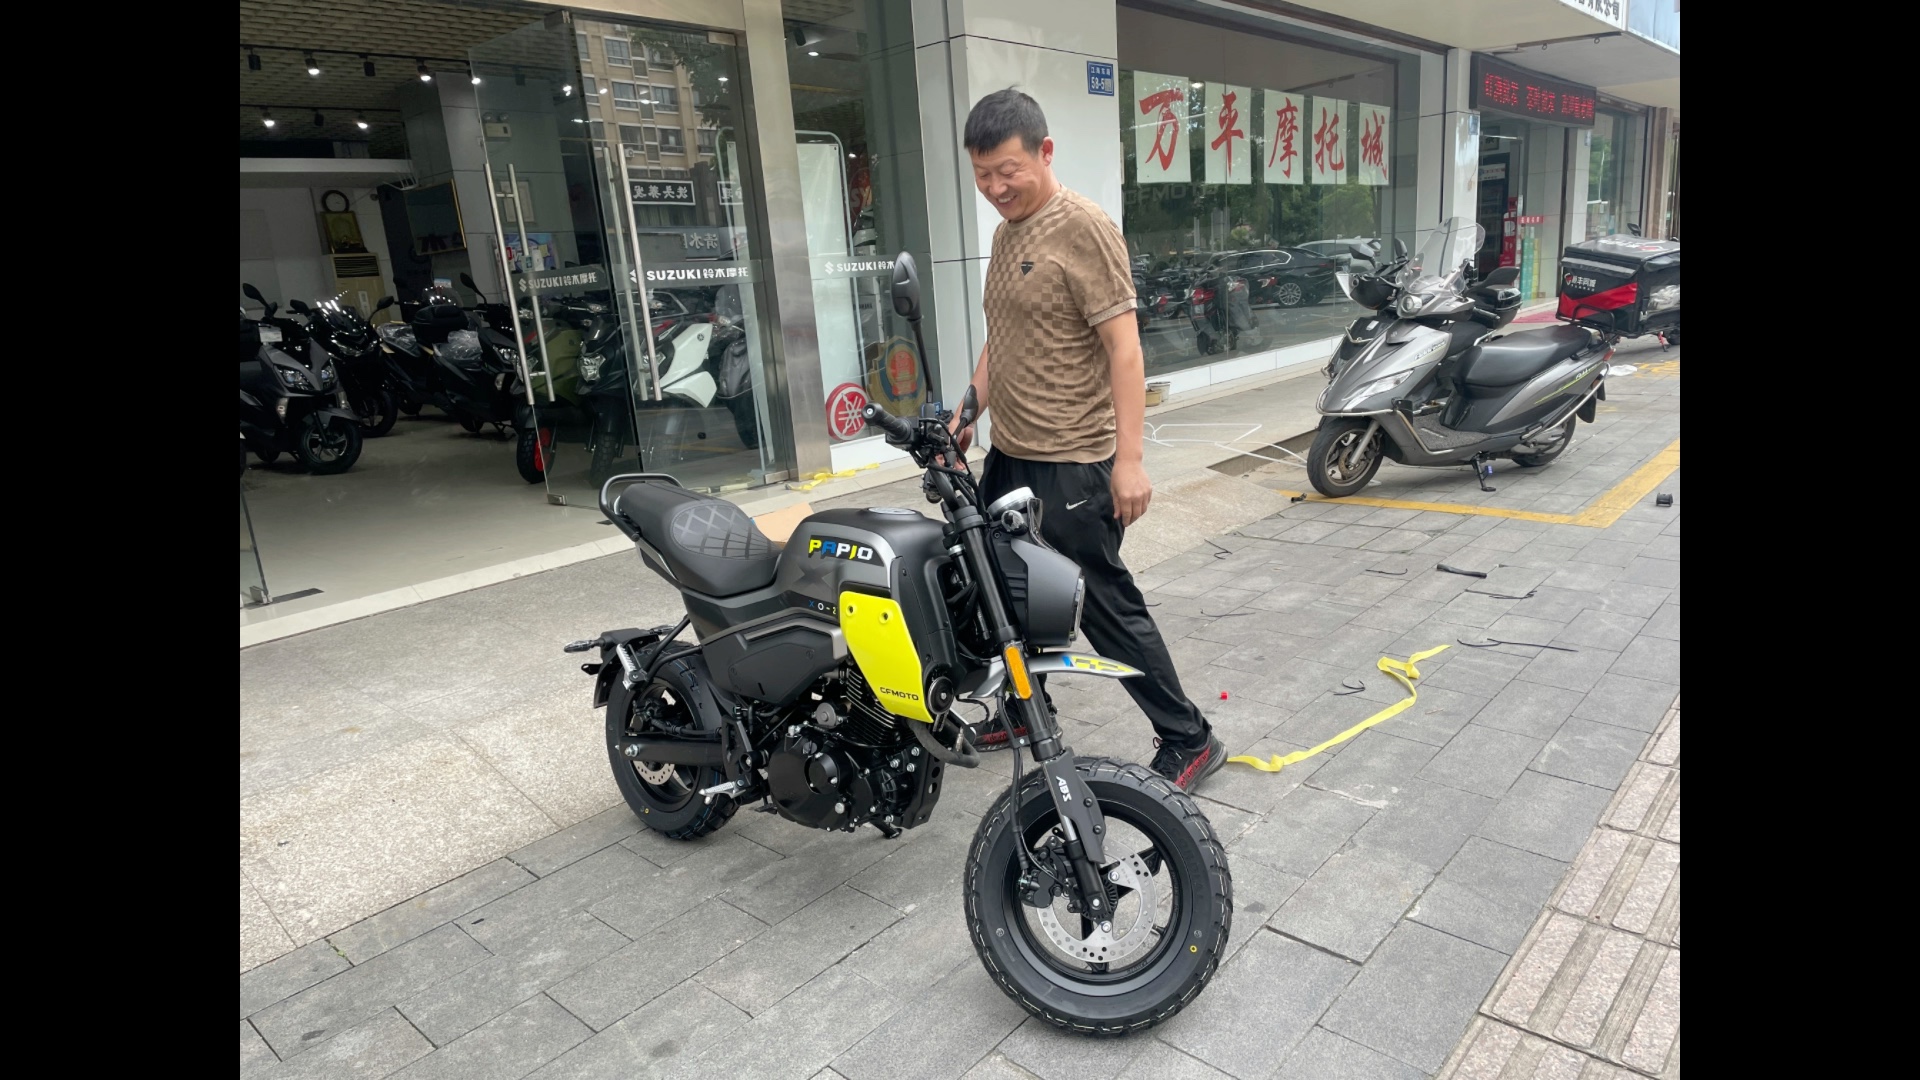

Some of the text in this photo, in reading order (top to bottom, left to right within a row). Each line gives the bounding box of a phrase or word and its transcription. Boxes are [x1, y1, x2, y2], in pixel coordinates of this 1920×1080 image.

[1138, 88, 1388, 180] 万平摩托城
[646, 267, 749, 281] SUZUKI 铃木摩托
[837, 262, 877, 272] SUZUKI
[528, 272, 598, 289] SUZUKI 铃木摩托
[808, 539, 874, 561] PAPIO
[880, 686, 920, 701] CFMOTO
[1055, 775, 1073, 803] ABS
